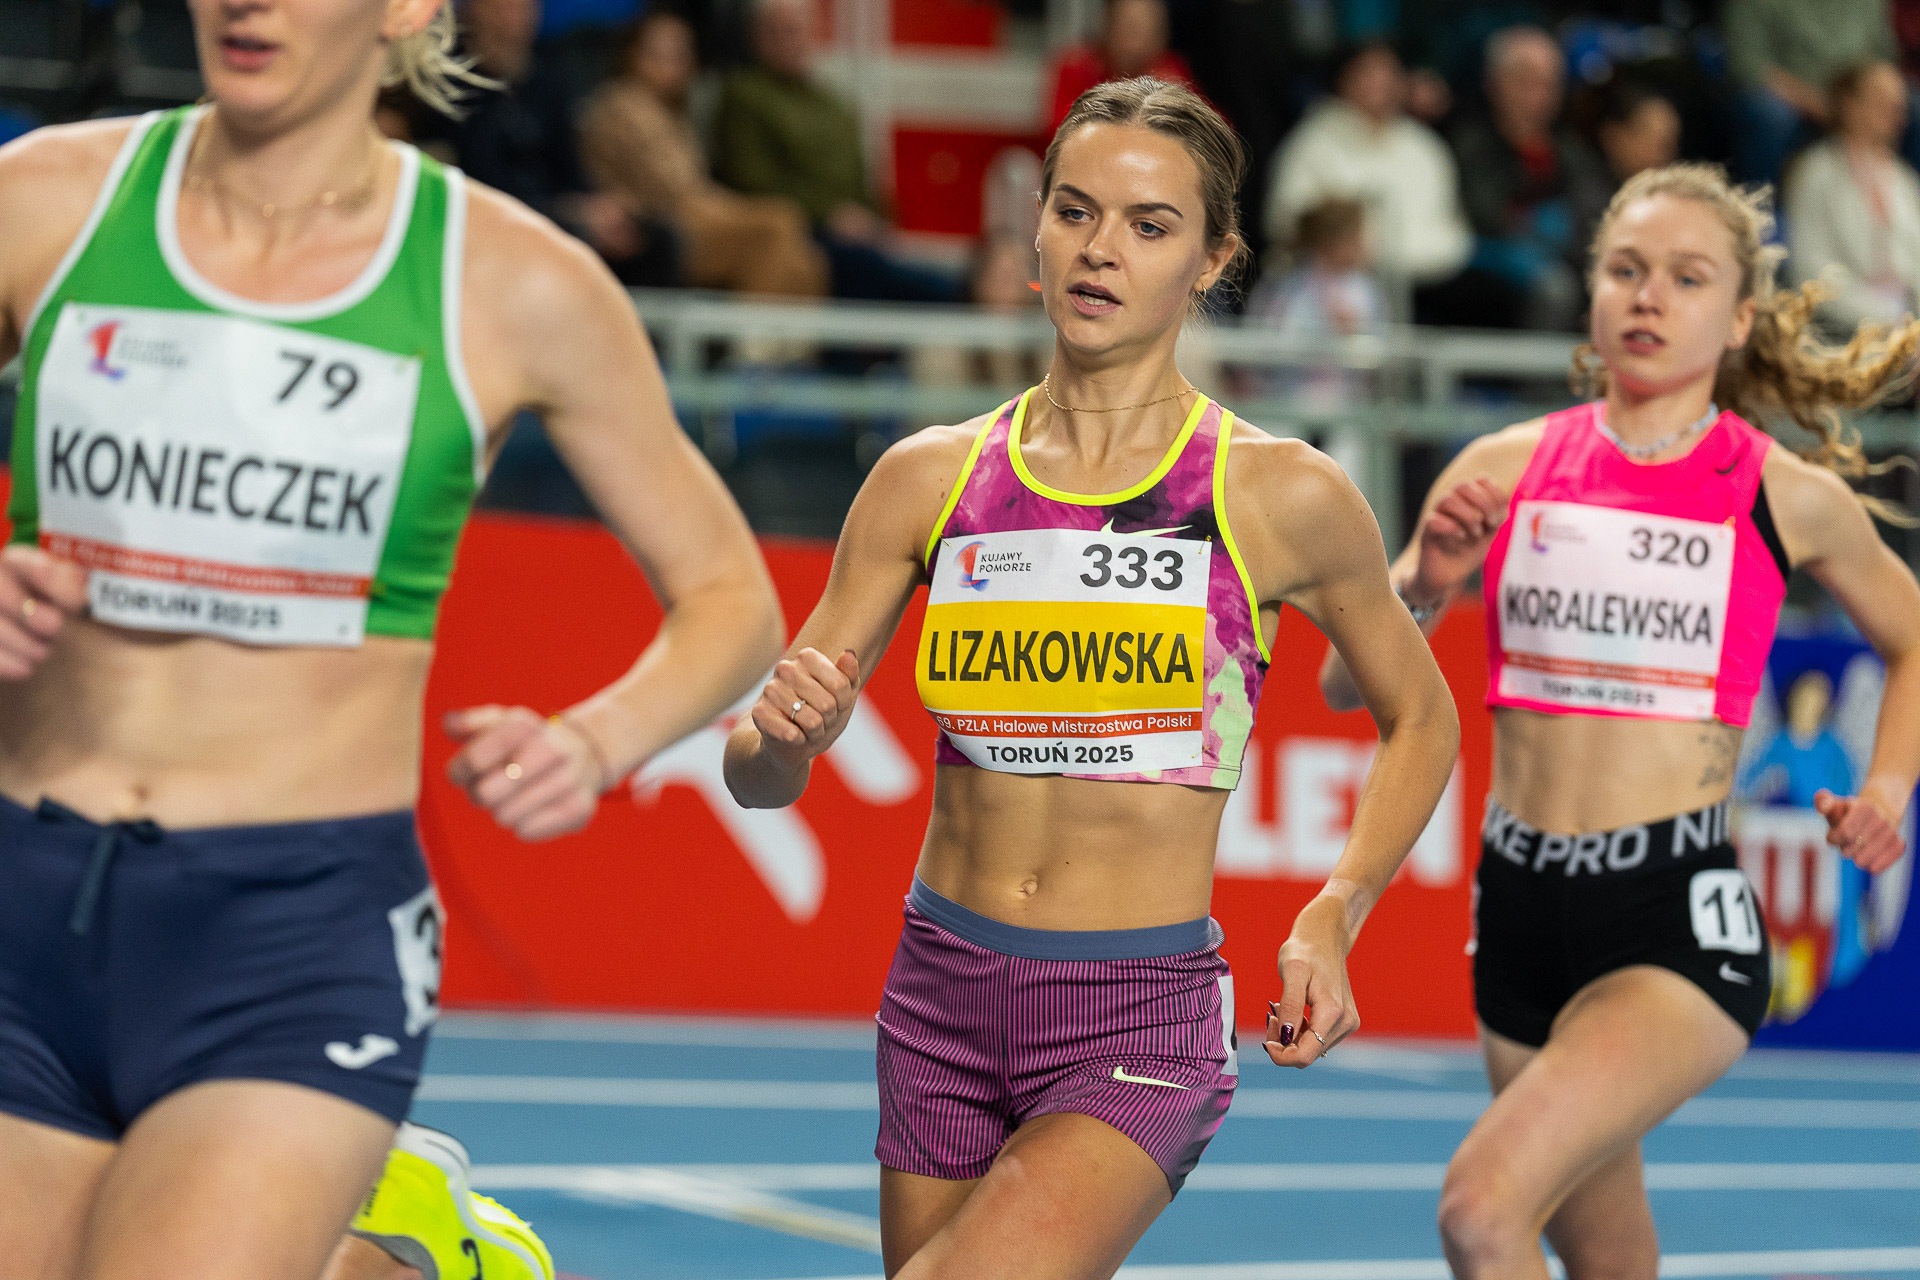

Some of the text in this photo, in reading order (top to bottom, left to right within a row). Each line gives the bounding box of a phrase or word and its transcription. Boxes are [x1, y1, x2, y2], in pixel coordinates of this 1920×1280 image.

[276, 348, 360, 411] 79
[48, 424, 384, 537] KONIECZEK
[979, 562, 1032, 573] POMORZE
[980, 551, 1023, 563] KUJAWY
[1079, 543, 1184, 591] 333
[1628, 526, 1710, 568] 320
[1505, 582, 1713, 645] KORALEWSKA
[928, 630, 1195, 684] LIZAKOWSKA
[936, 714, 1192, 734] 69. PZLA Halowe Mistrzostwa Polski
[986, 741, 1134, 764] TORUŃ 2025
[1532, 823, 1650, 877] PRO
[1702, 884, 1754, 938] 11
